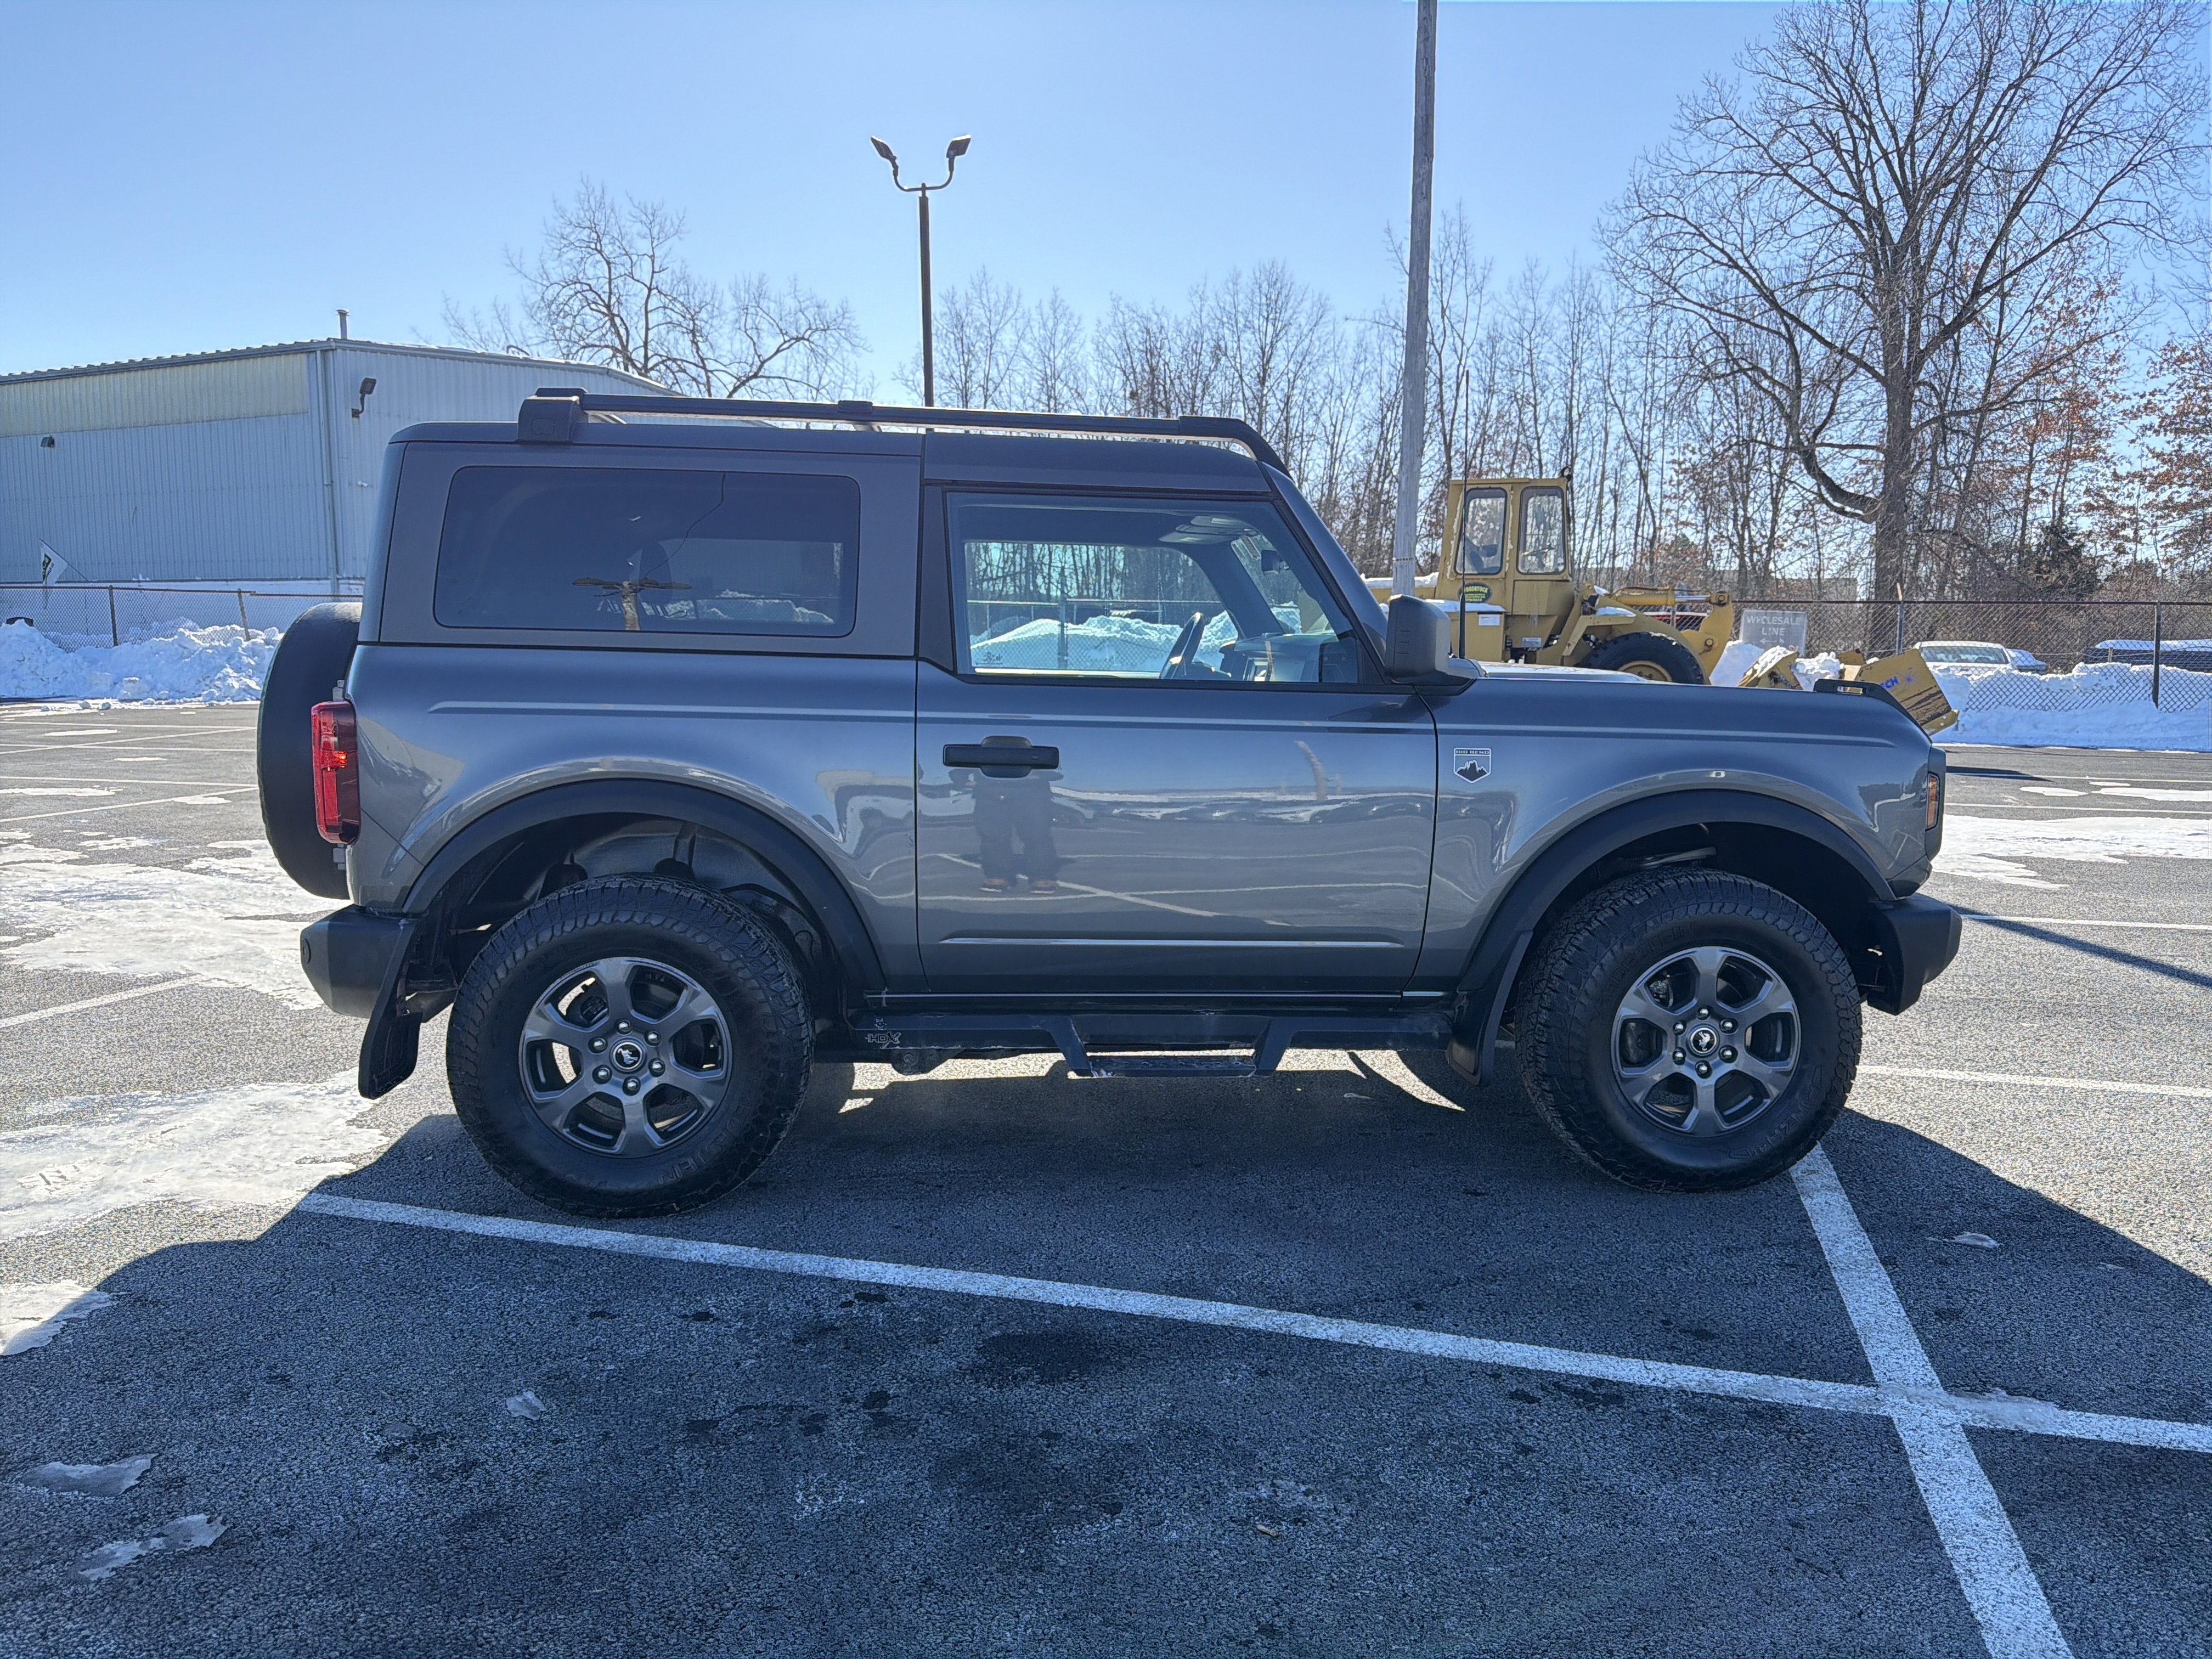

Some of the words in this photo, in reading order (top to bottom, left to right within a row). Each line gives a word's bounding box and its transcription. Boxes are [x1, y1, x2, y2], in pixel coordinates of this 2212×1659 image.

[1747, 616, 1802, 625] WHOLESALE
[1762, 627, 1786, 636] LINE
[867, 1031, 901, 1049] HDX
